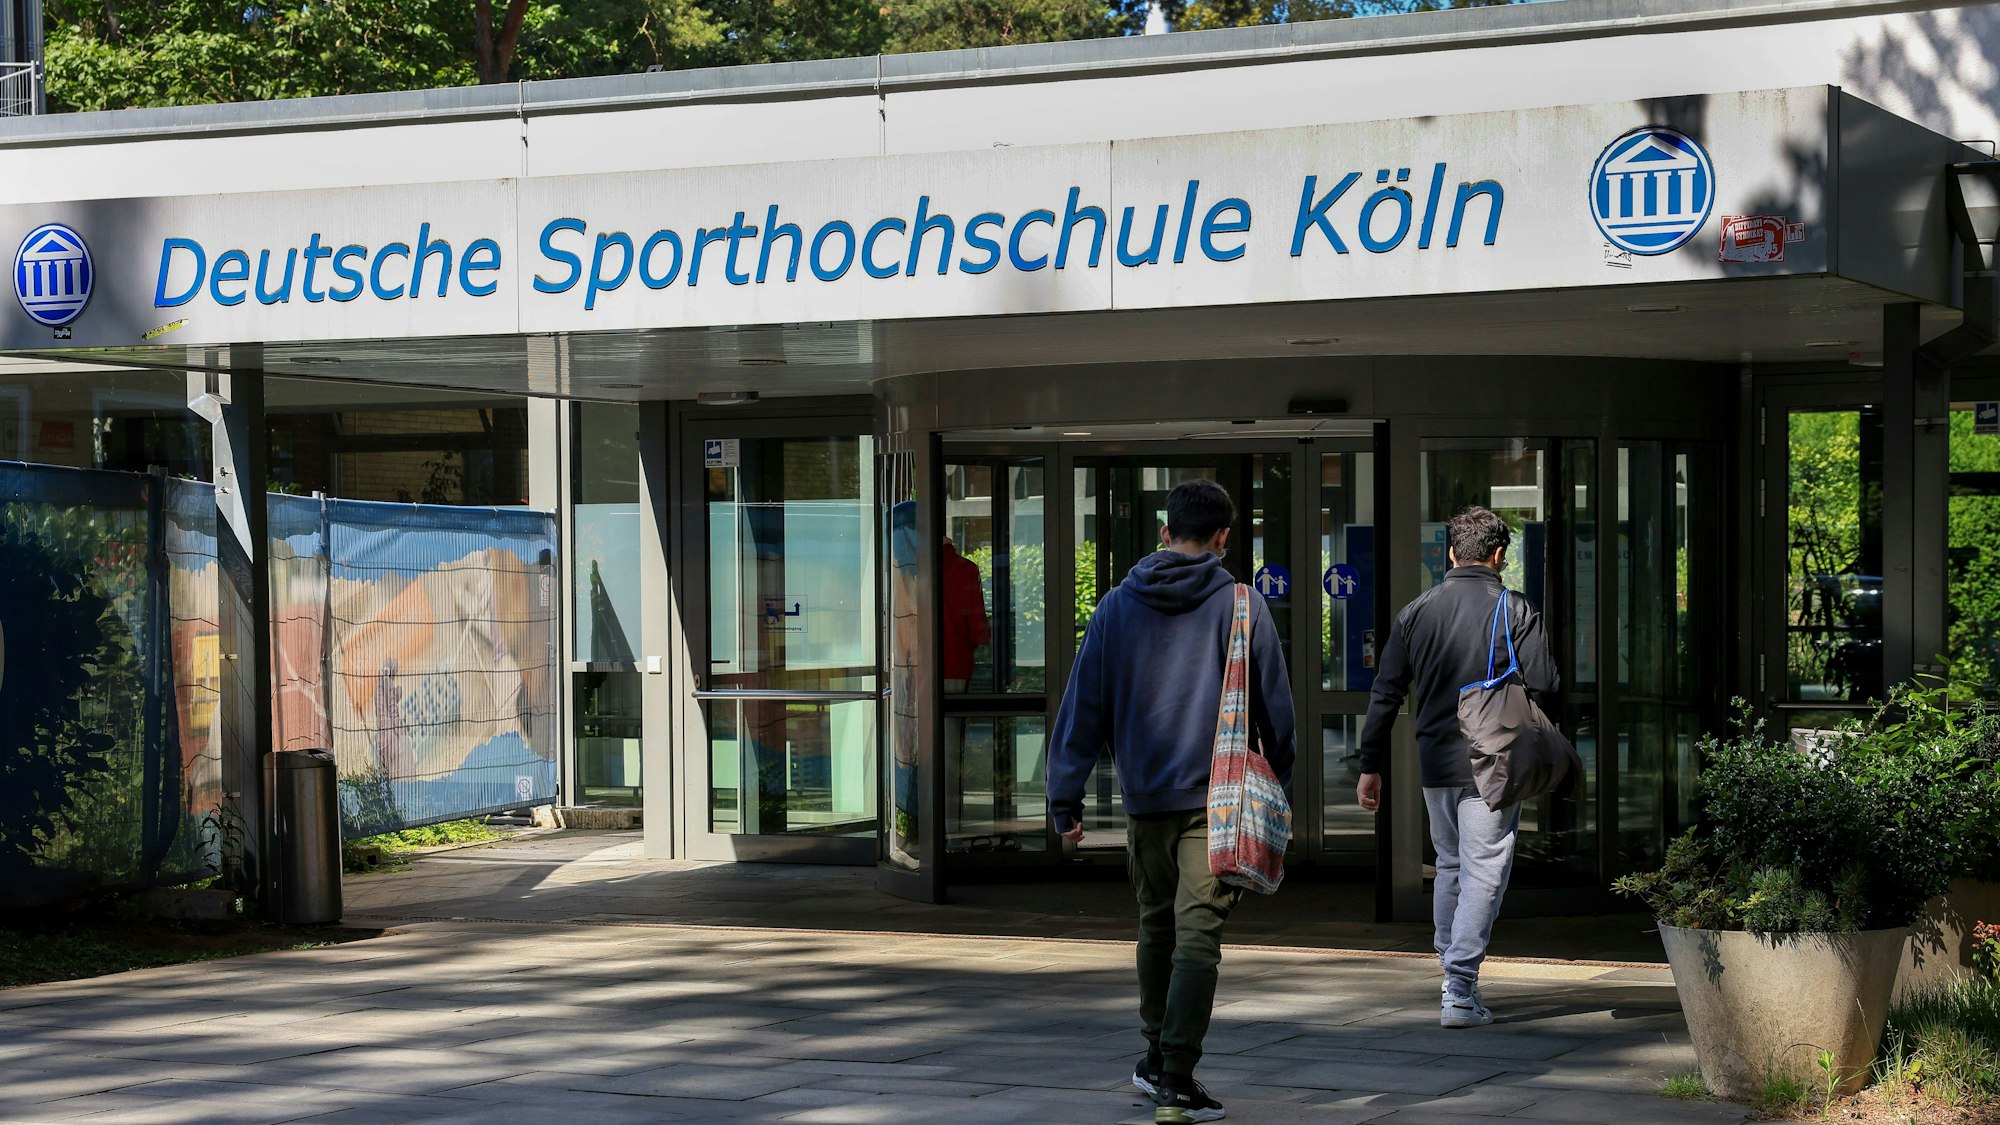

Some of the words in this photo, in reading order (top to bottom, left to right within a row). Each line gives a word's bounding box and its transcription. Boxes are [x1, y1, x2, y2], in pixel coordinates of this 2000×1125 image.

[154, 222, 501, 308] Deutsche
[532, 180, 1252, 311] Sporthochschule
[1289, 162, 1505, 257] Köln
